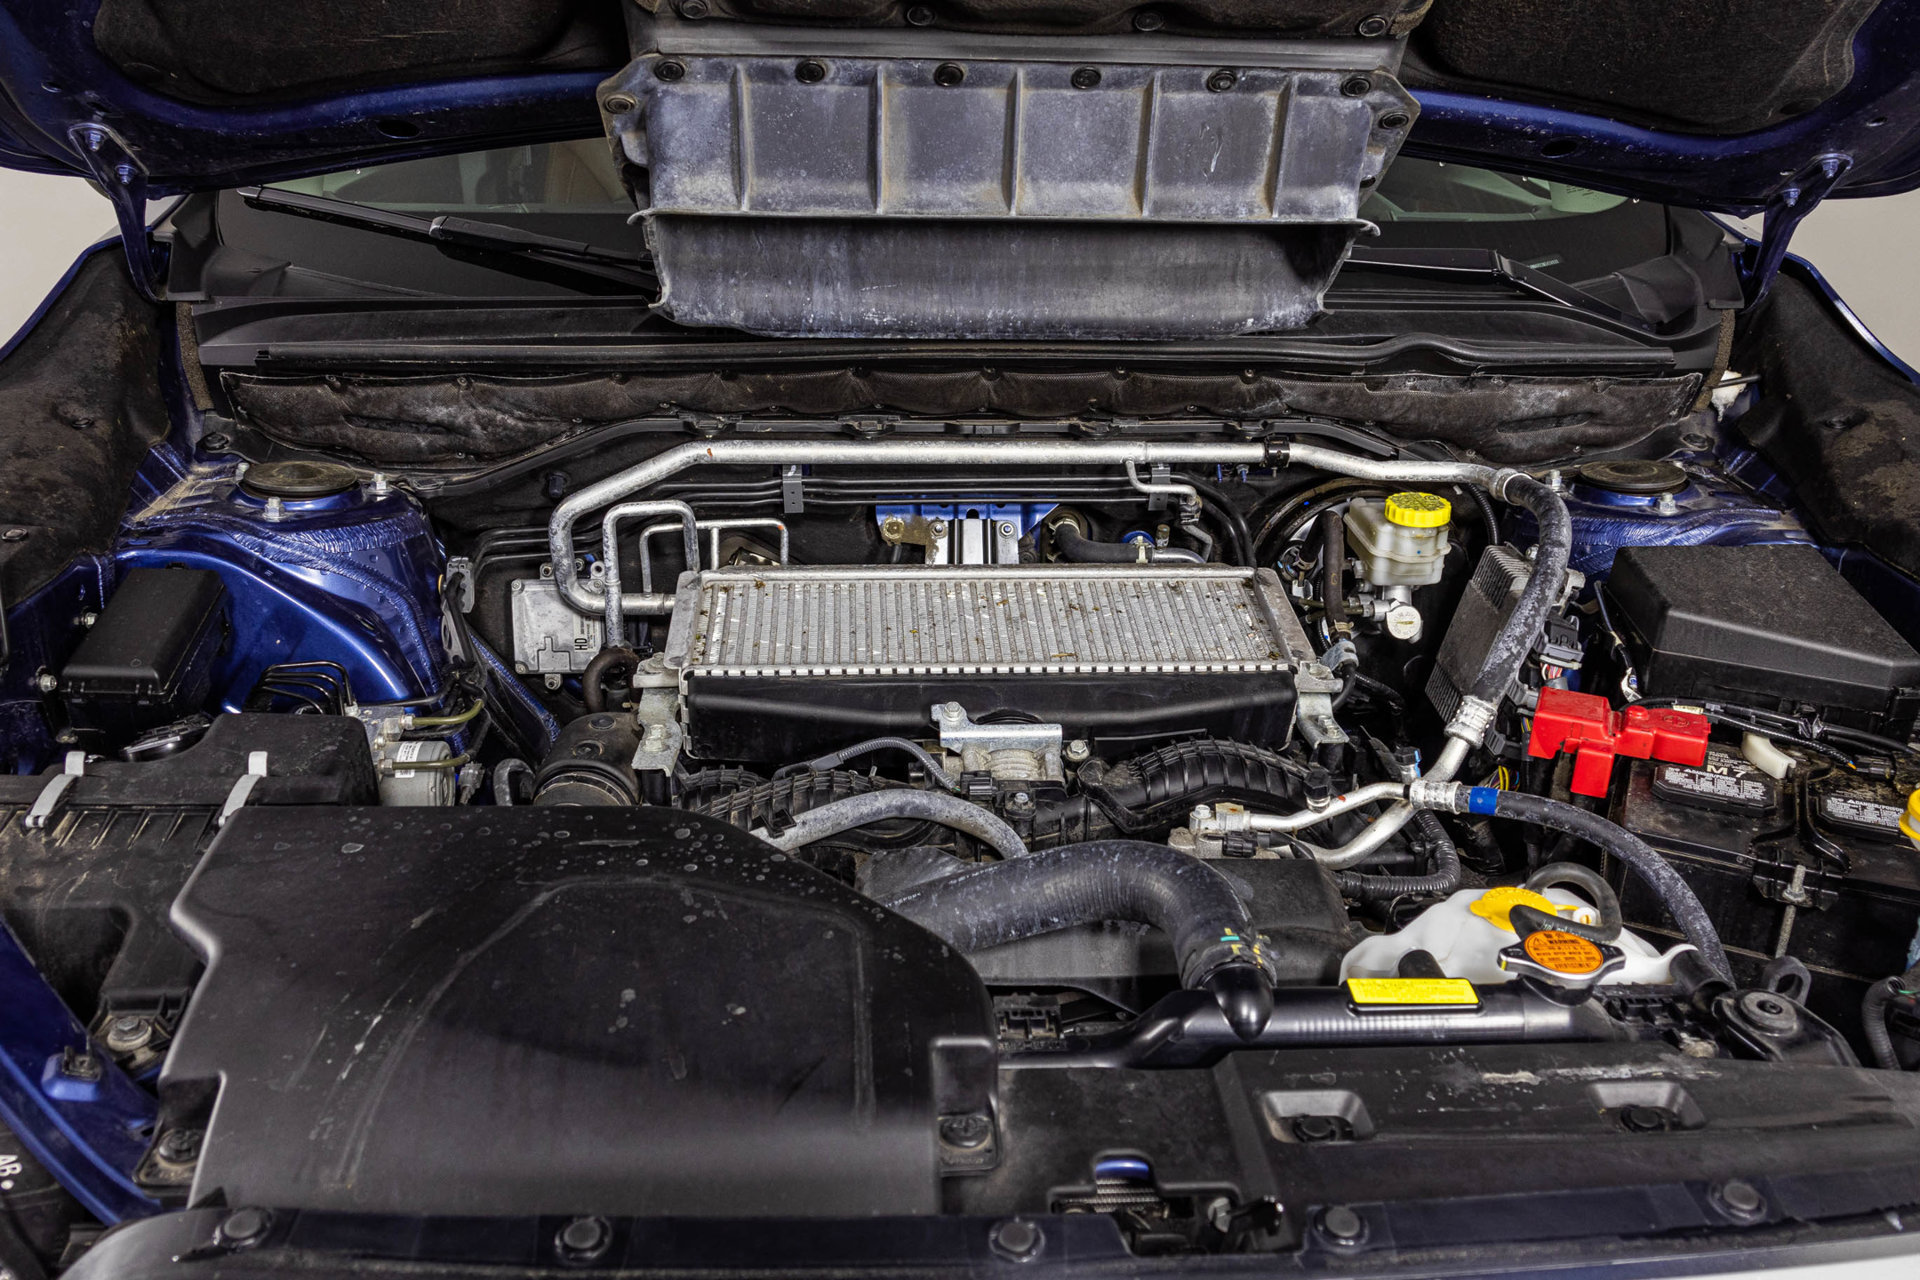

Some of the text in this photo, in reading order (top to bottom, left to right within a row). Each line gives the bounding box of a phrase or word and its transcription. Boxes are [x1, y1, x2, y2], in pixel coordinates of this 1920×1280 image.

[574, 637, 588, 651] HD
[1706, 764, 1746, 778] M 7
